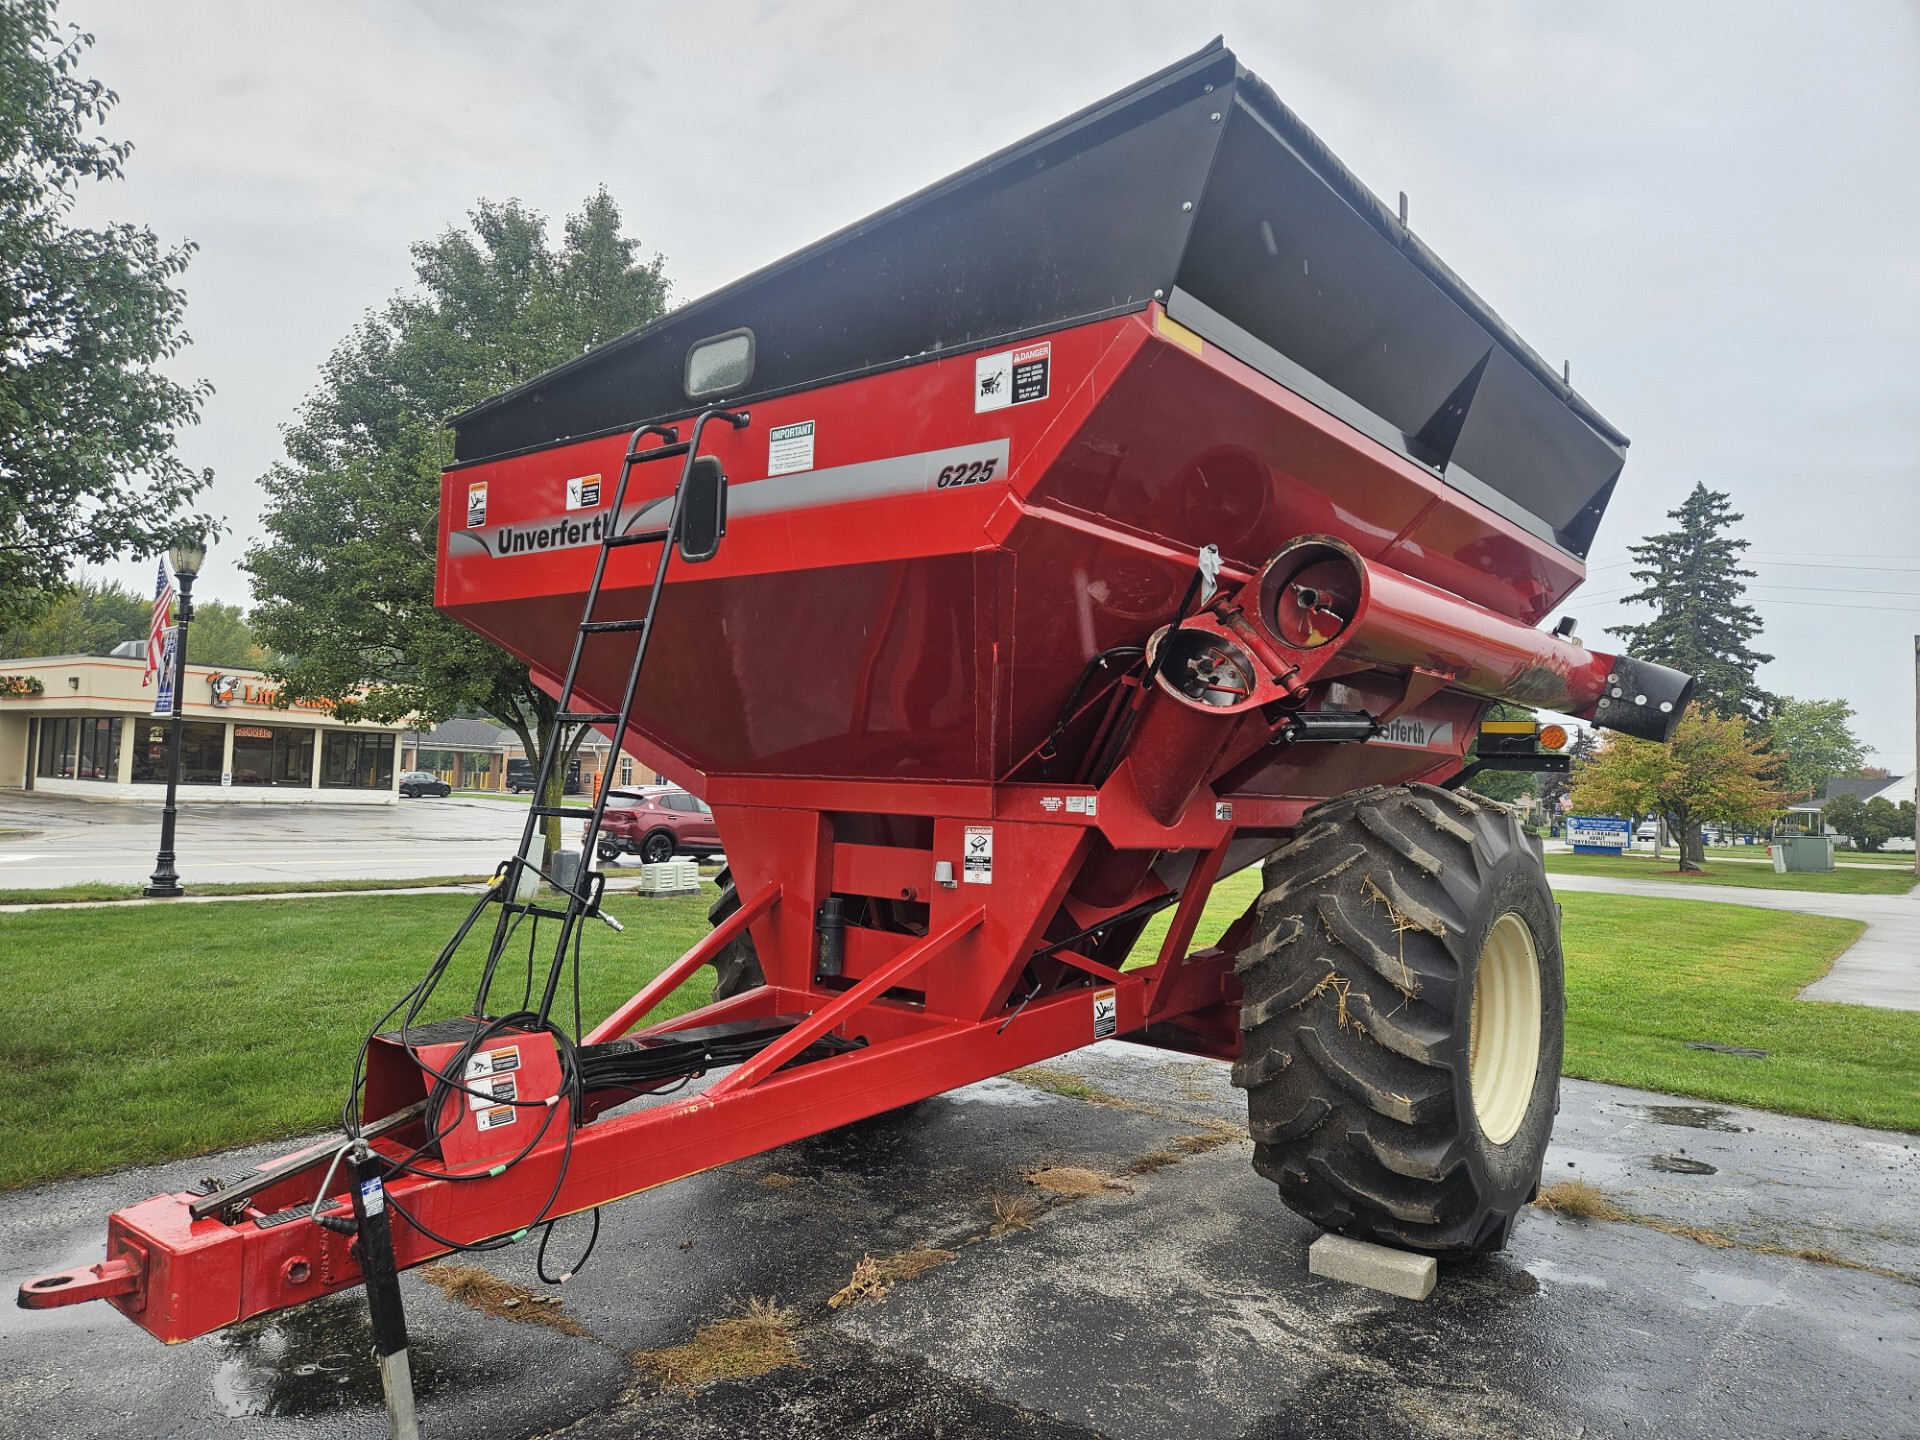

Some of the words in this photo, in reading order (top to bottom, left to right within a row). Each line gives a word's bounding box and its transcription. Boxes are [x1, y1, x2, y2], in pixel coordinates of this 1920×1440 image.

[1020, 347, 1048, 360] DANGER
[772, 424, 812, 440] IMPORTANT
[937, 458, 999, 488] 6225
[245, 685, 280, 704] Litt
